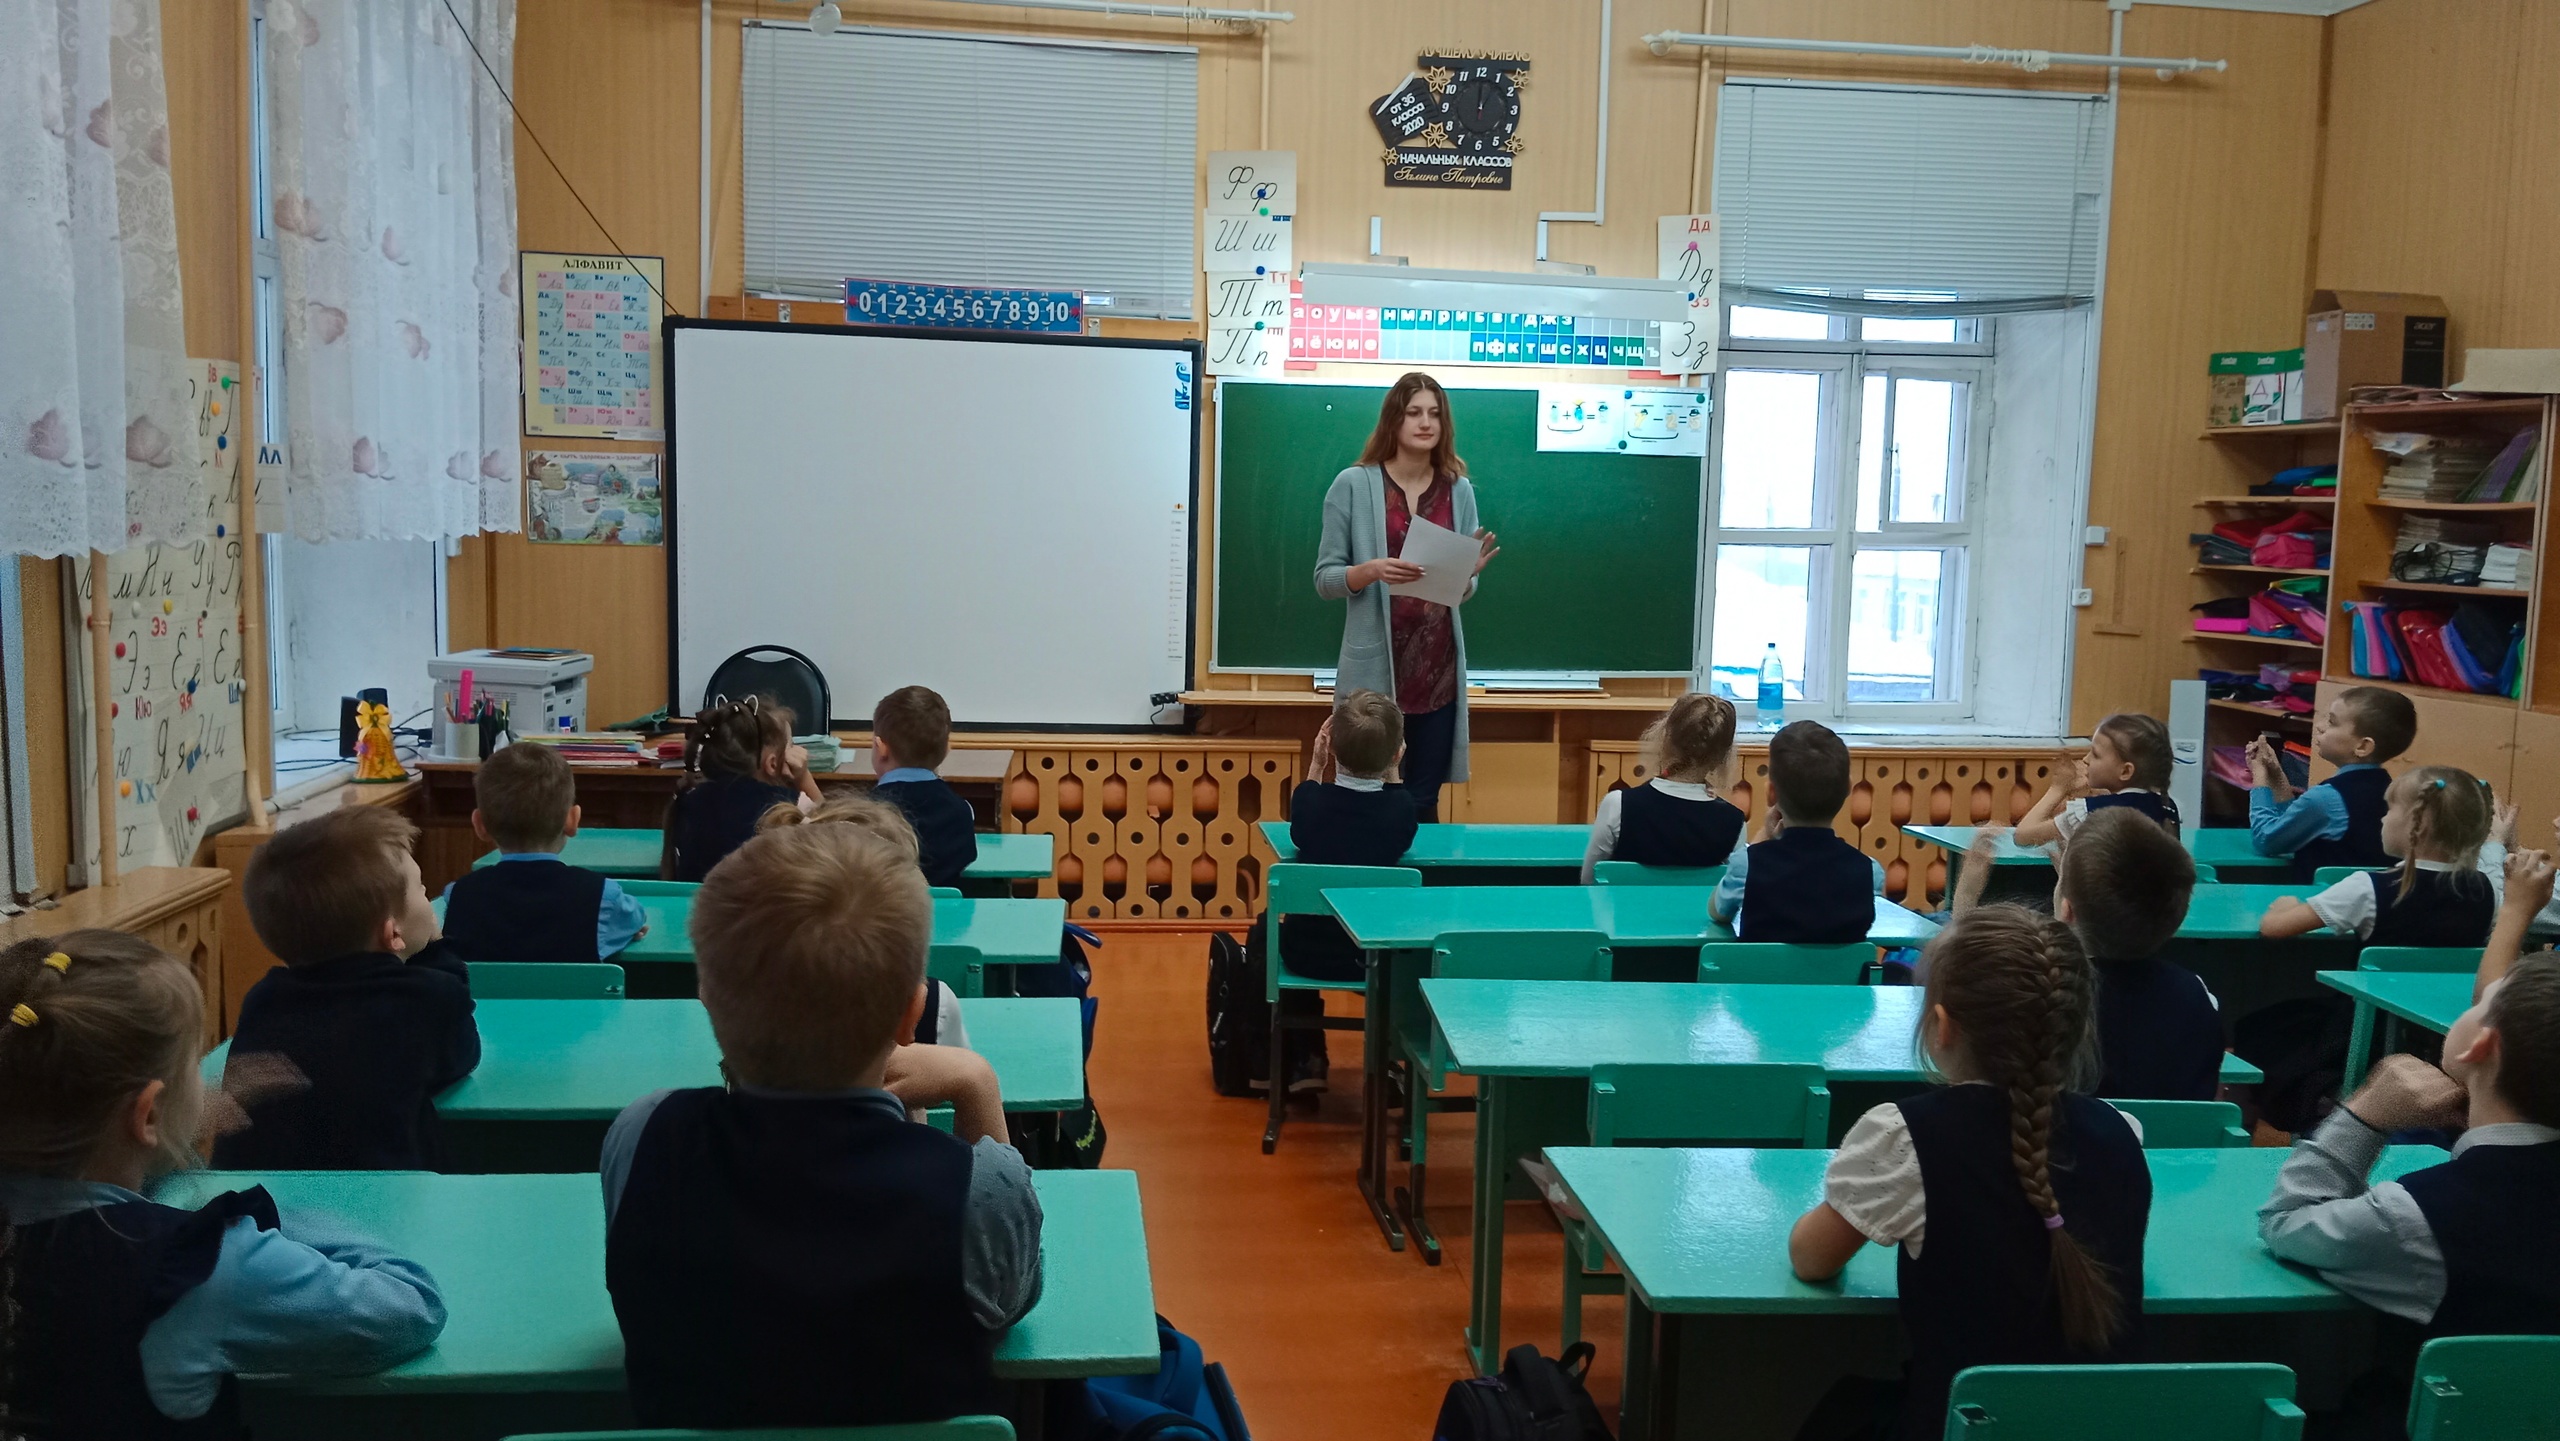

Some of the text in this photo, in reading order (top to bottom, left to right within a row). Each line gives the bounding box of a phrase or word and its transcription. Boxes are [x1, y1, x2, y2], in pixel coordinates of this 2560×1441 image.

[1459, 71, 1469, 81] 11
[1476, 67, 1487, 77] 12
[1495, 73, 1501, 83] 1
[1446, 84, 1456, 94] 10
[1507, 87, 1514, 97] 2
[1442, 103, 1449, 113] 9
[1510, 105, 1518, 115] 3
[1402, 116, 1425, 135] 2020
[1446, 121, 1453, 131] 8
[1505, 123, 1512, 133] 4
[1458, 134, 1465, 145] 7
[1493, 136, 1500, 146] 5
[1475, 140, 1482, 150] 6
[1400, 153, 1512, 168] НАЧАЛЬНЫХ КЛАССОВ
[1394, 166, 1504, 188] Галине Петровне
[562, 259, 623, 270] АЛФАВИТ
[859, 292, 1069, 322] 0 1 2 3 4 5 6 7 8 9 10
